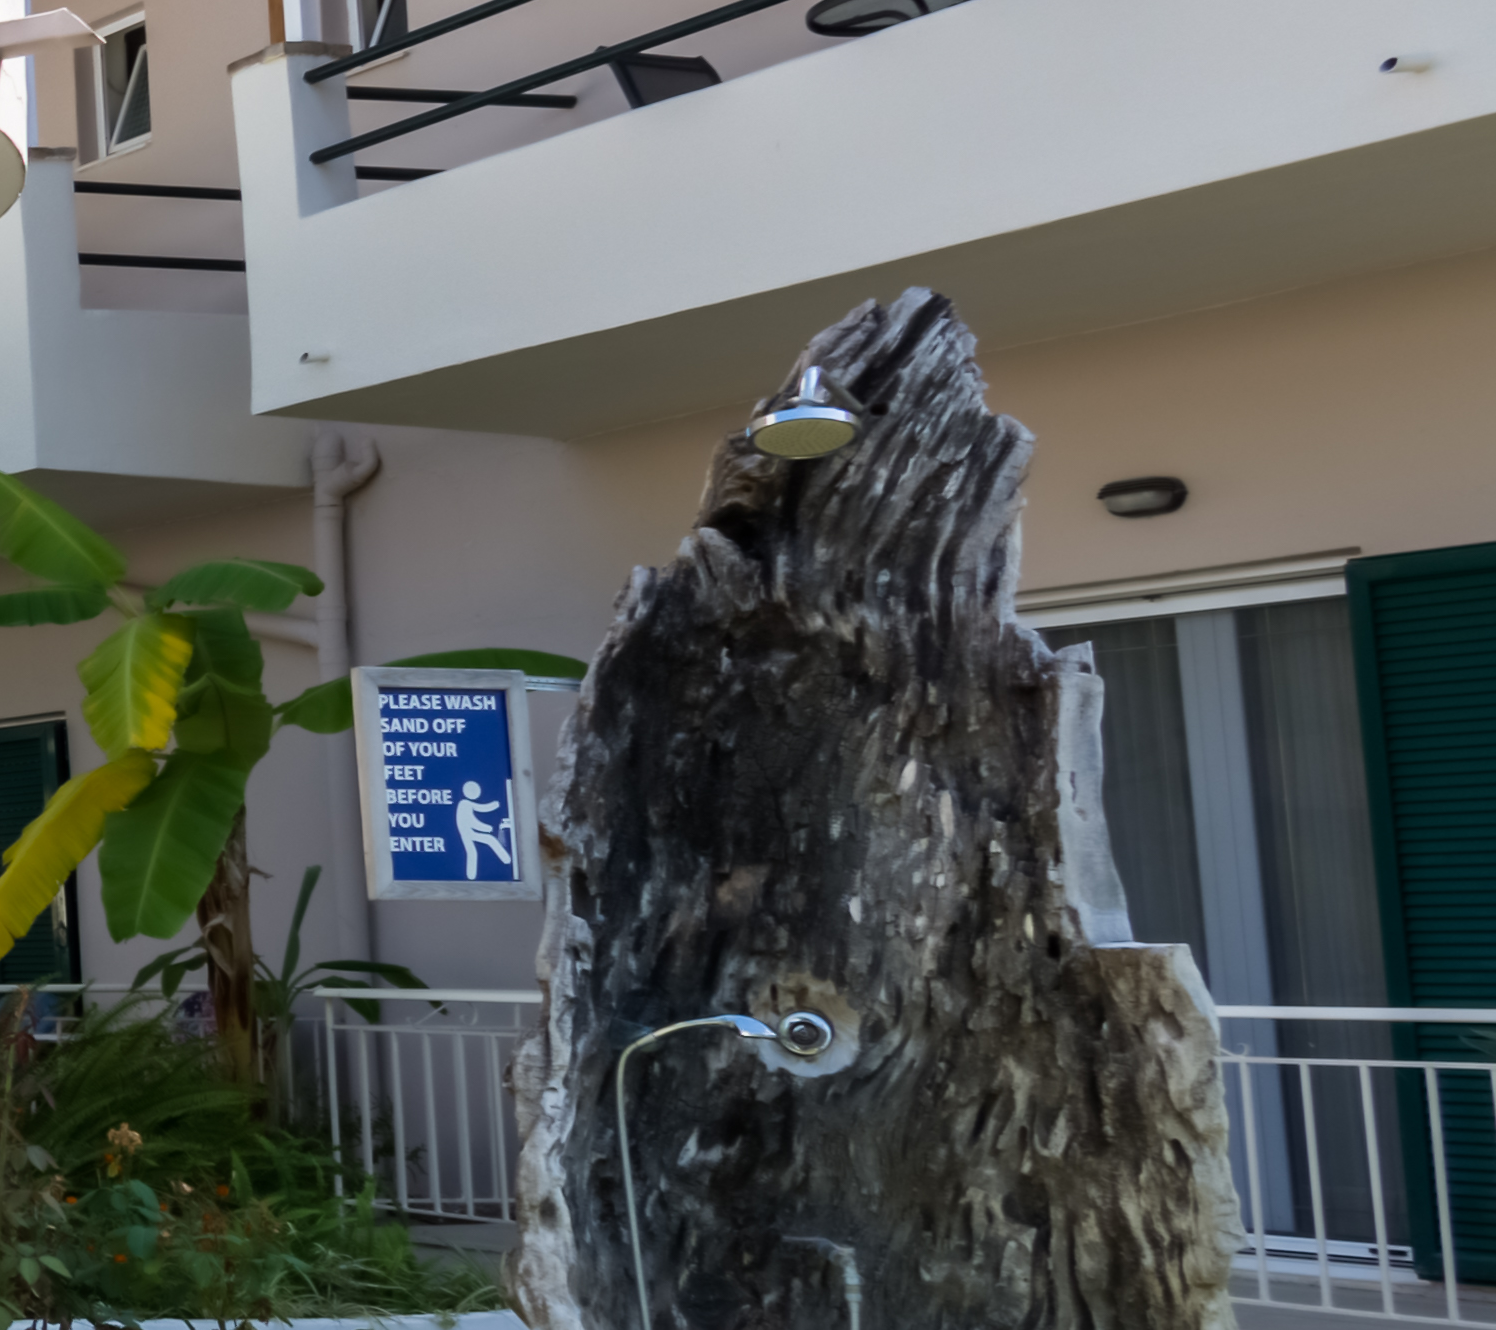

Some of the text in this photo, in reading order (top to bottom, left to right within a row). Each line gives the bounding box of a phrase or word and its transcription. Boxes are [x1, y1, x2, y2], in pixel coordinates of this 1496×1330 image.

[378, 694, 496, 710] PLEASE WASH
[380, 718, 466, 733] SAND OFF
[382, 741, 458, 757] OF YOUR
[384, 765, 425, 780] FEET
[385, 789, 453, 804] BEFORE
[388, 813, 424, 828] YOU
[389, 836, 446, 852] ENTER
